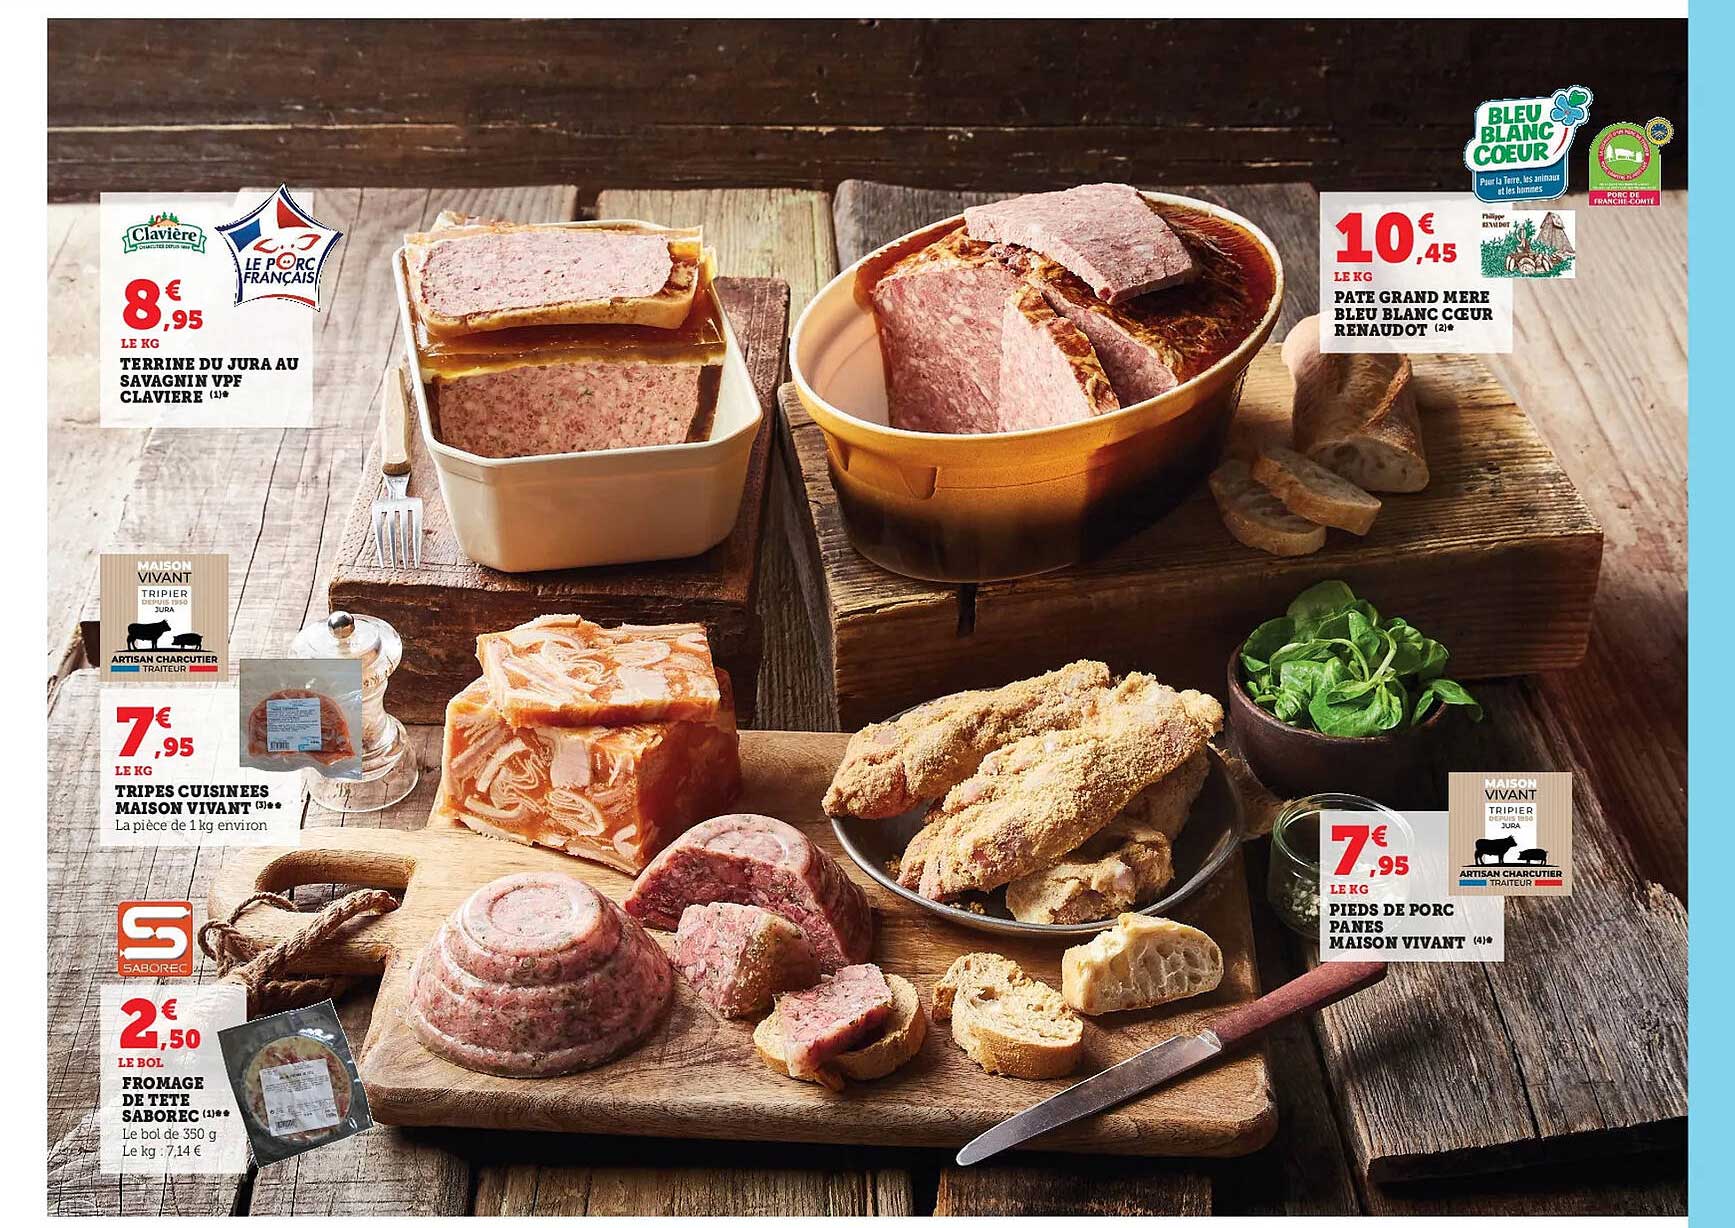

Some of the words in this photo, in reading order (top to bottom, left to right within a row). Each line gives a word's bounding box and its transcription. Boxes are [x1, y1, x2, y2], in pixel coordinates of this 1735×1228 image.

[1488, 104, 1542, 125] BLEU
[1481, 122, 1554, 143] BLANC
[1480, 178, 1494, 186] Pour
[1534, 174, 1560, 182] animaux
[1517, 186, 1542, 194] hommes
[132, 227, 197, 241] Clavière
[1335, 212, 1414, 264] 10
[246, 258, 261, 270] LE
[266, 252, 315, 271] PORC
[244, 272, 315, 286] FRANÇAIS
[1334, 272, 1352, 281] LE
[1354, 272, 1373, 282] KG
[123, 278, 161, 330] 8
[1334, 291, 1375, 304] PATE
[1379, 291, 1438, 304] GRAND
[1442, 291, 1490, 304] MERE
[1334, 308, 1378, 321] BLEU
[1382, 308, 1438, 321] BLANC
[1334, 324, 1428, 337] RENAUDOT
[121, 339, 137, 348] LE
[141, 338, 160, 348] KG
[120, 358, 195, 370] TERRINE
[199, 358, 222, 370] DU
[228, 358, 272, 371] JURA
[275, 358, 299, 370] AU
[120, 374, 208, 387] SAVAGNIN
[212, 375, 242, 387] VPF
[120, 390, 203, 403] CLAVIERE
[137, 561, 192, 571] MAISON
[138, 572, 192, 583] VIVANT
[142, 590, 188, 598] TRIPIER
[112, 656, 154, 664] ARTISAN
[156, 656, 218, 664] CHARCUTIER
[116, 706, 154, 757] 7
[115, 766, 132, 776] LE
[134, 766, 152, 776] KG
[1485, 779, 1537, 788] MAISON
[115, 785, 174, 798] TRIPES
[178, 785, 269, 798] CUISINEES
[1485, 790, 1537, 800] VIVANT
[115, 802, 182, 814] MAISON
[184, 802, 251, 814] VIVANT
[115, 820, 131, 831] La
[133, 819, 169, 833] pièce
[172, 820, 186, 831] de
[190, 820, 196, 831] 1
[198, 819, 214, 834] kg
[218, 820, 268, 831] environ
[1331, 825, 1370, 876] 7
[1502, 870, 1562, 878] CHARCUTIER
[1330, 885, 1346, 894] LE
[1349, 884, 1369, 894] KG
[1329, 904, 1379, 917] PIEDS
[1383, 904, 1405, 916] DE
[1409, 904, 1454, 917] PORC
[1329, 920, 1384, 933] PANES
[1329, 936, 1398, 950] MAISON
[1401, 936, 1466, 949] VIVANT
[123, 963, 188, 973] SABOREC
[120, 998, 157, 1049] 2
[118, 1058, 135, 1068] LE
[137, 1058, 163, 1068] BOL
[122, 1077, 204, 1090] FROMAGE
[122, 1094, 144, 1107] DE
[148, 1094, 190, 1107] TETE
[122, 1110, 199, 1123] SABOREC
[122, 1128, 138, 1140] Le
[141, 1128, 160, 1140] bol
[164, 1128, 180, 1140] de
[183, 1129, 205, 1140] 350
[208, 1131, 216, 1142] g
[122, 1145, 138, 1157] Le
[141, 1145, 156, 1160] kg
[166, 1145, 190, 1158] 7,14
[194, 1146, 201, 1157] €
